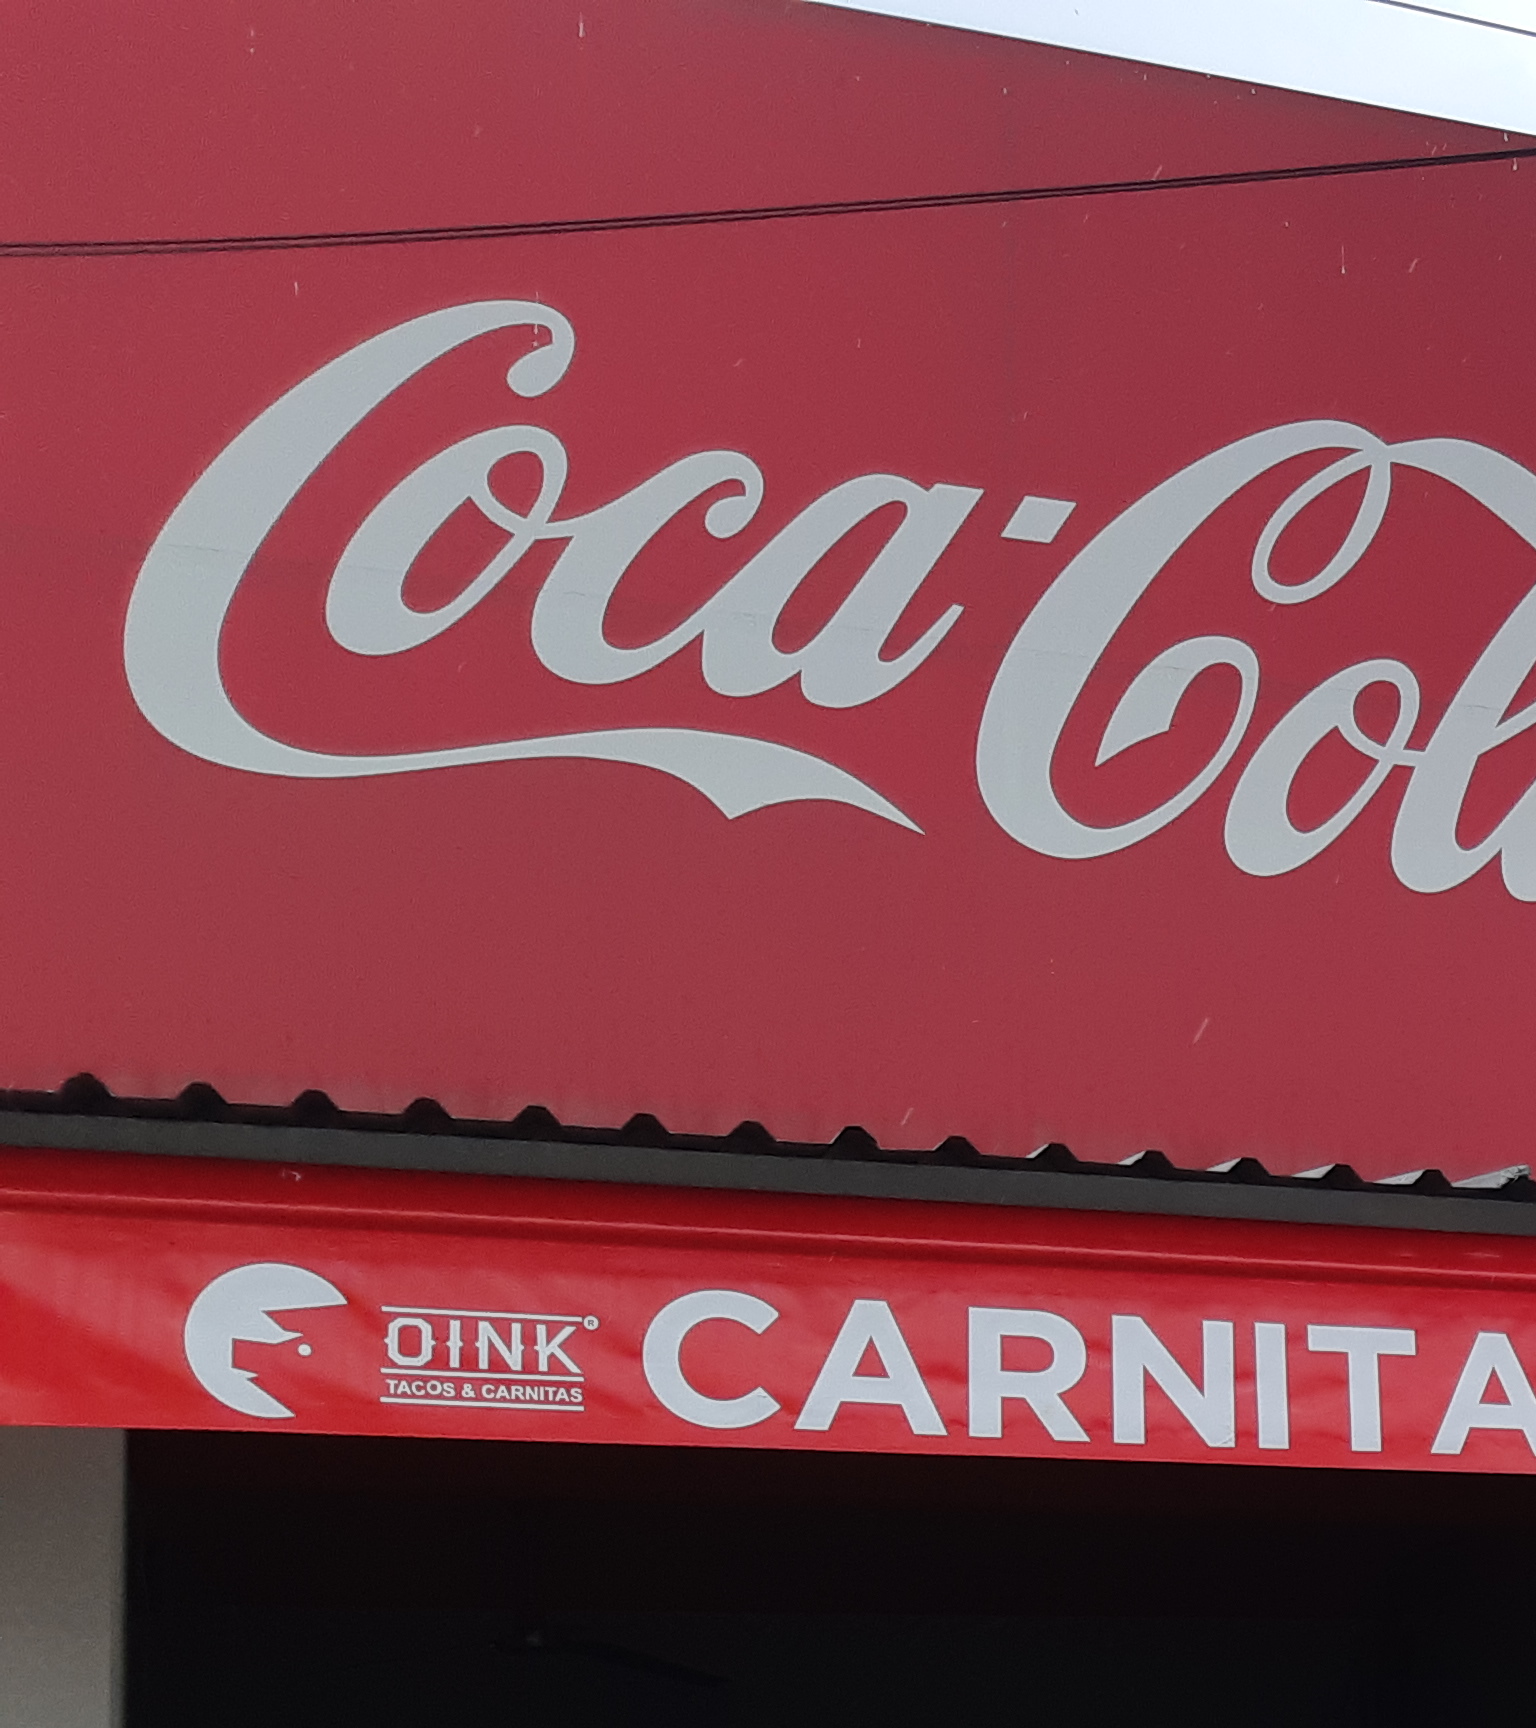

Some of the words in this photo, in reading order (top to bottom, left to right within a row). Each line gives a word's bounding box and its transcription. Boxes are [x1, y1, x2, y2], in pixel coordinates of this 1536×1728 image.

[385, 1379, 456, 1397] TACOS
[461, 1383, 476, 1398] &
[481, 1384, 583, 1403] CARNITAS
